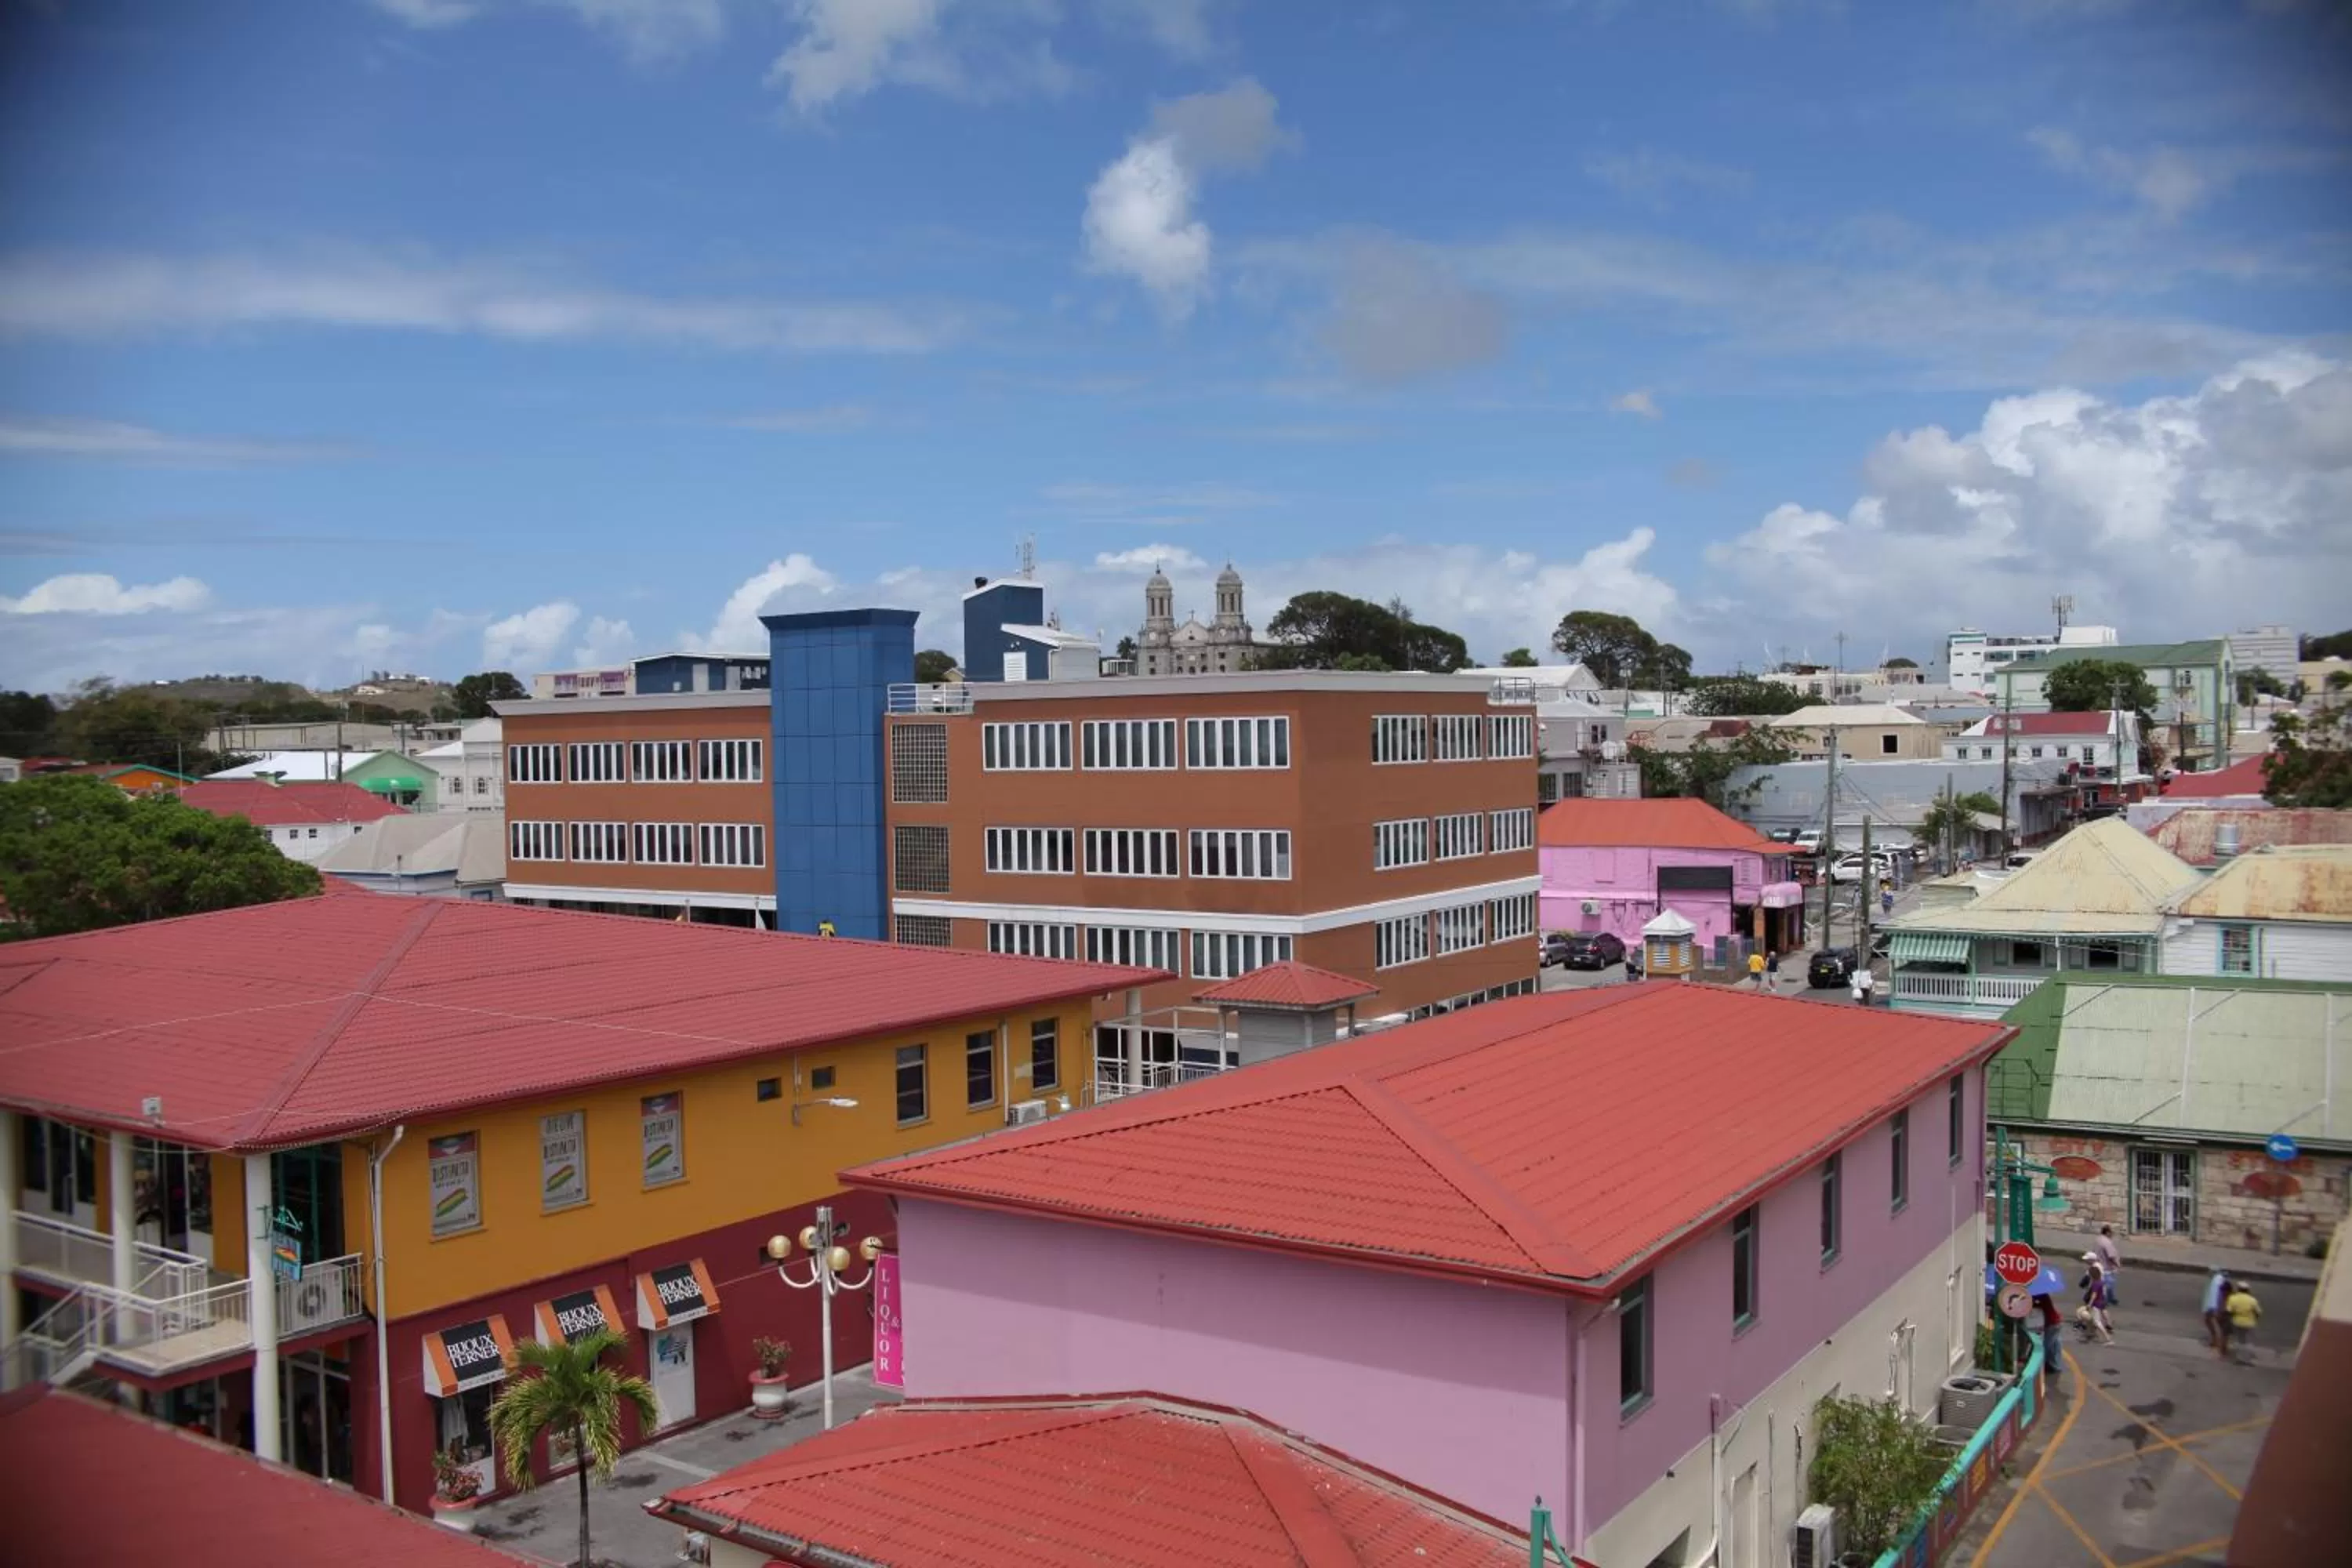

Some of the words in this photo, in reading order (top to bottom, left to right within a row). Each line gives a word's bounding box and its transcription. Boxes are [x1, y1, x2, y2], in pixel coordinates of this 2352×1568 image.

[1998, 1254, 2037, 1272] STOP
[658, 1275, 697, 1295] BIJOUX
[663, 1285, 702, 1305] TERNER
[558, 1302, 602, 1323] BIJOUX
[880, 1268, 891, 1371] LIQUOR
[563, 1313, 608, 1335] TERNER
[447, 1333, 493, 1356] BIJOUX
[452, 1344, 499, 1368] TERNER
